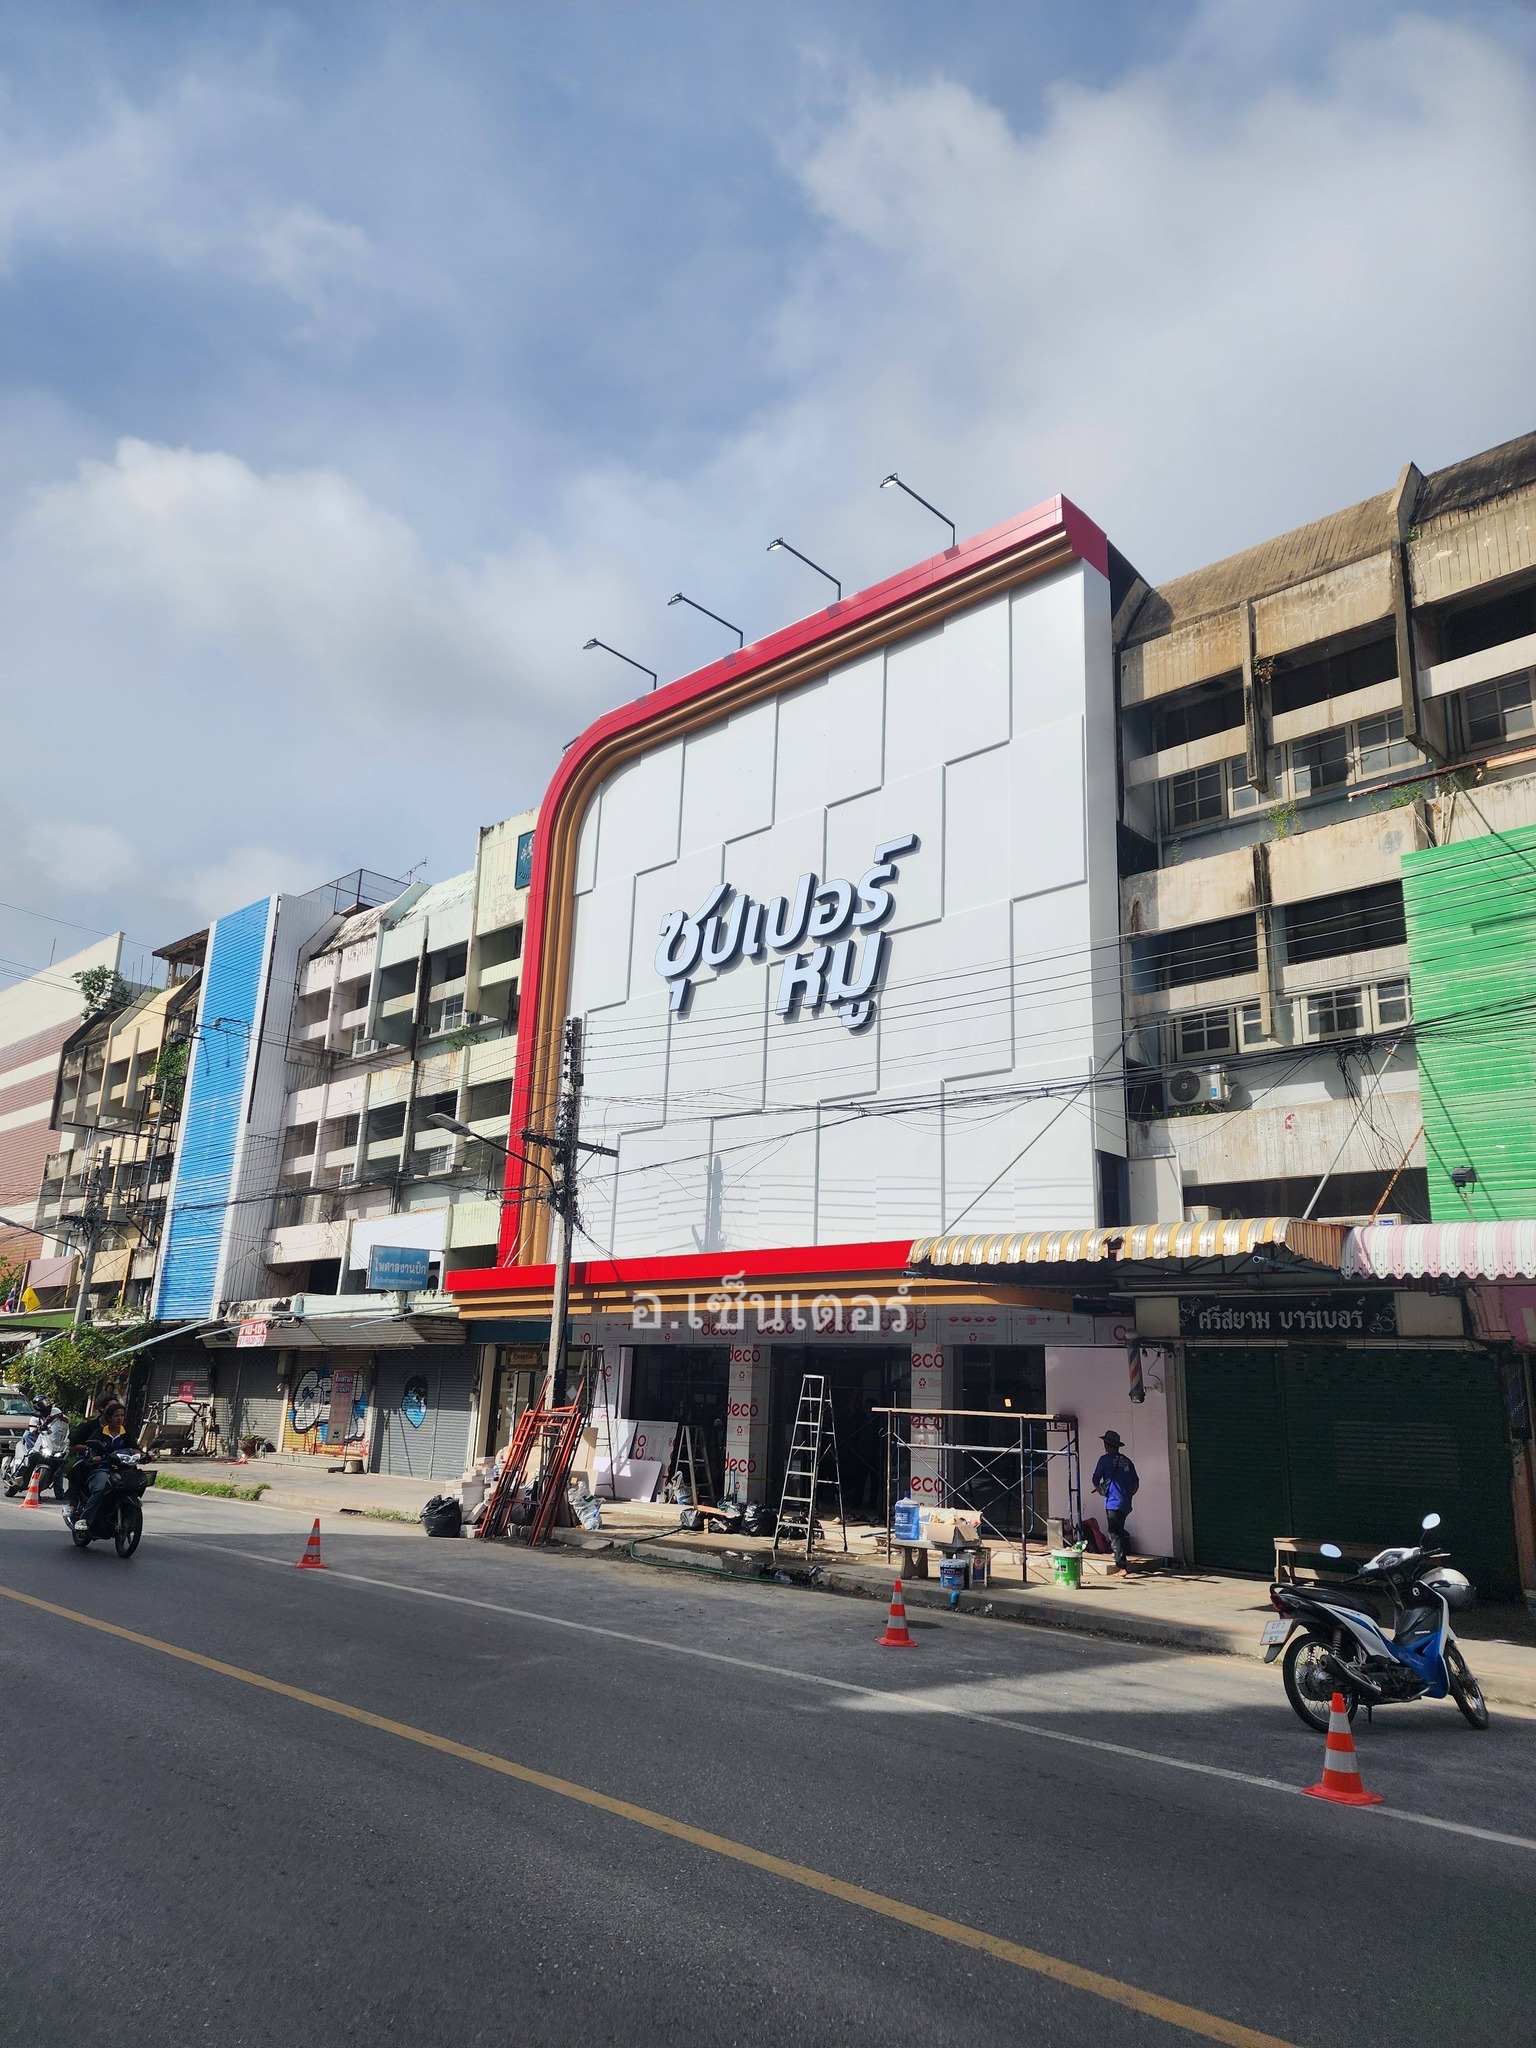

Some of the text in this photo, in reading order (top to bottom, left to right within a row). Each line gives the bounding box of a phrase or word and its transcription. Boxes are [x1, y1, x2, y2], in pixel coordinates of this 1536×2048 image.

[654, 833, 922, 1012] ซุปเปอร์
[775, 930, 887, 1031] หมู
[1198, 1295, 1367, 1330] ศรีสยาม บาร์เบอร์
